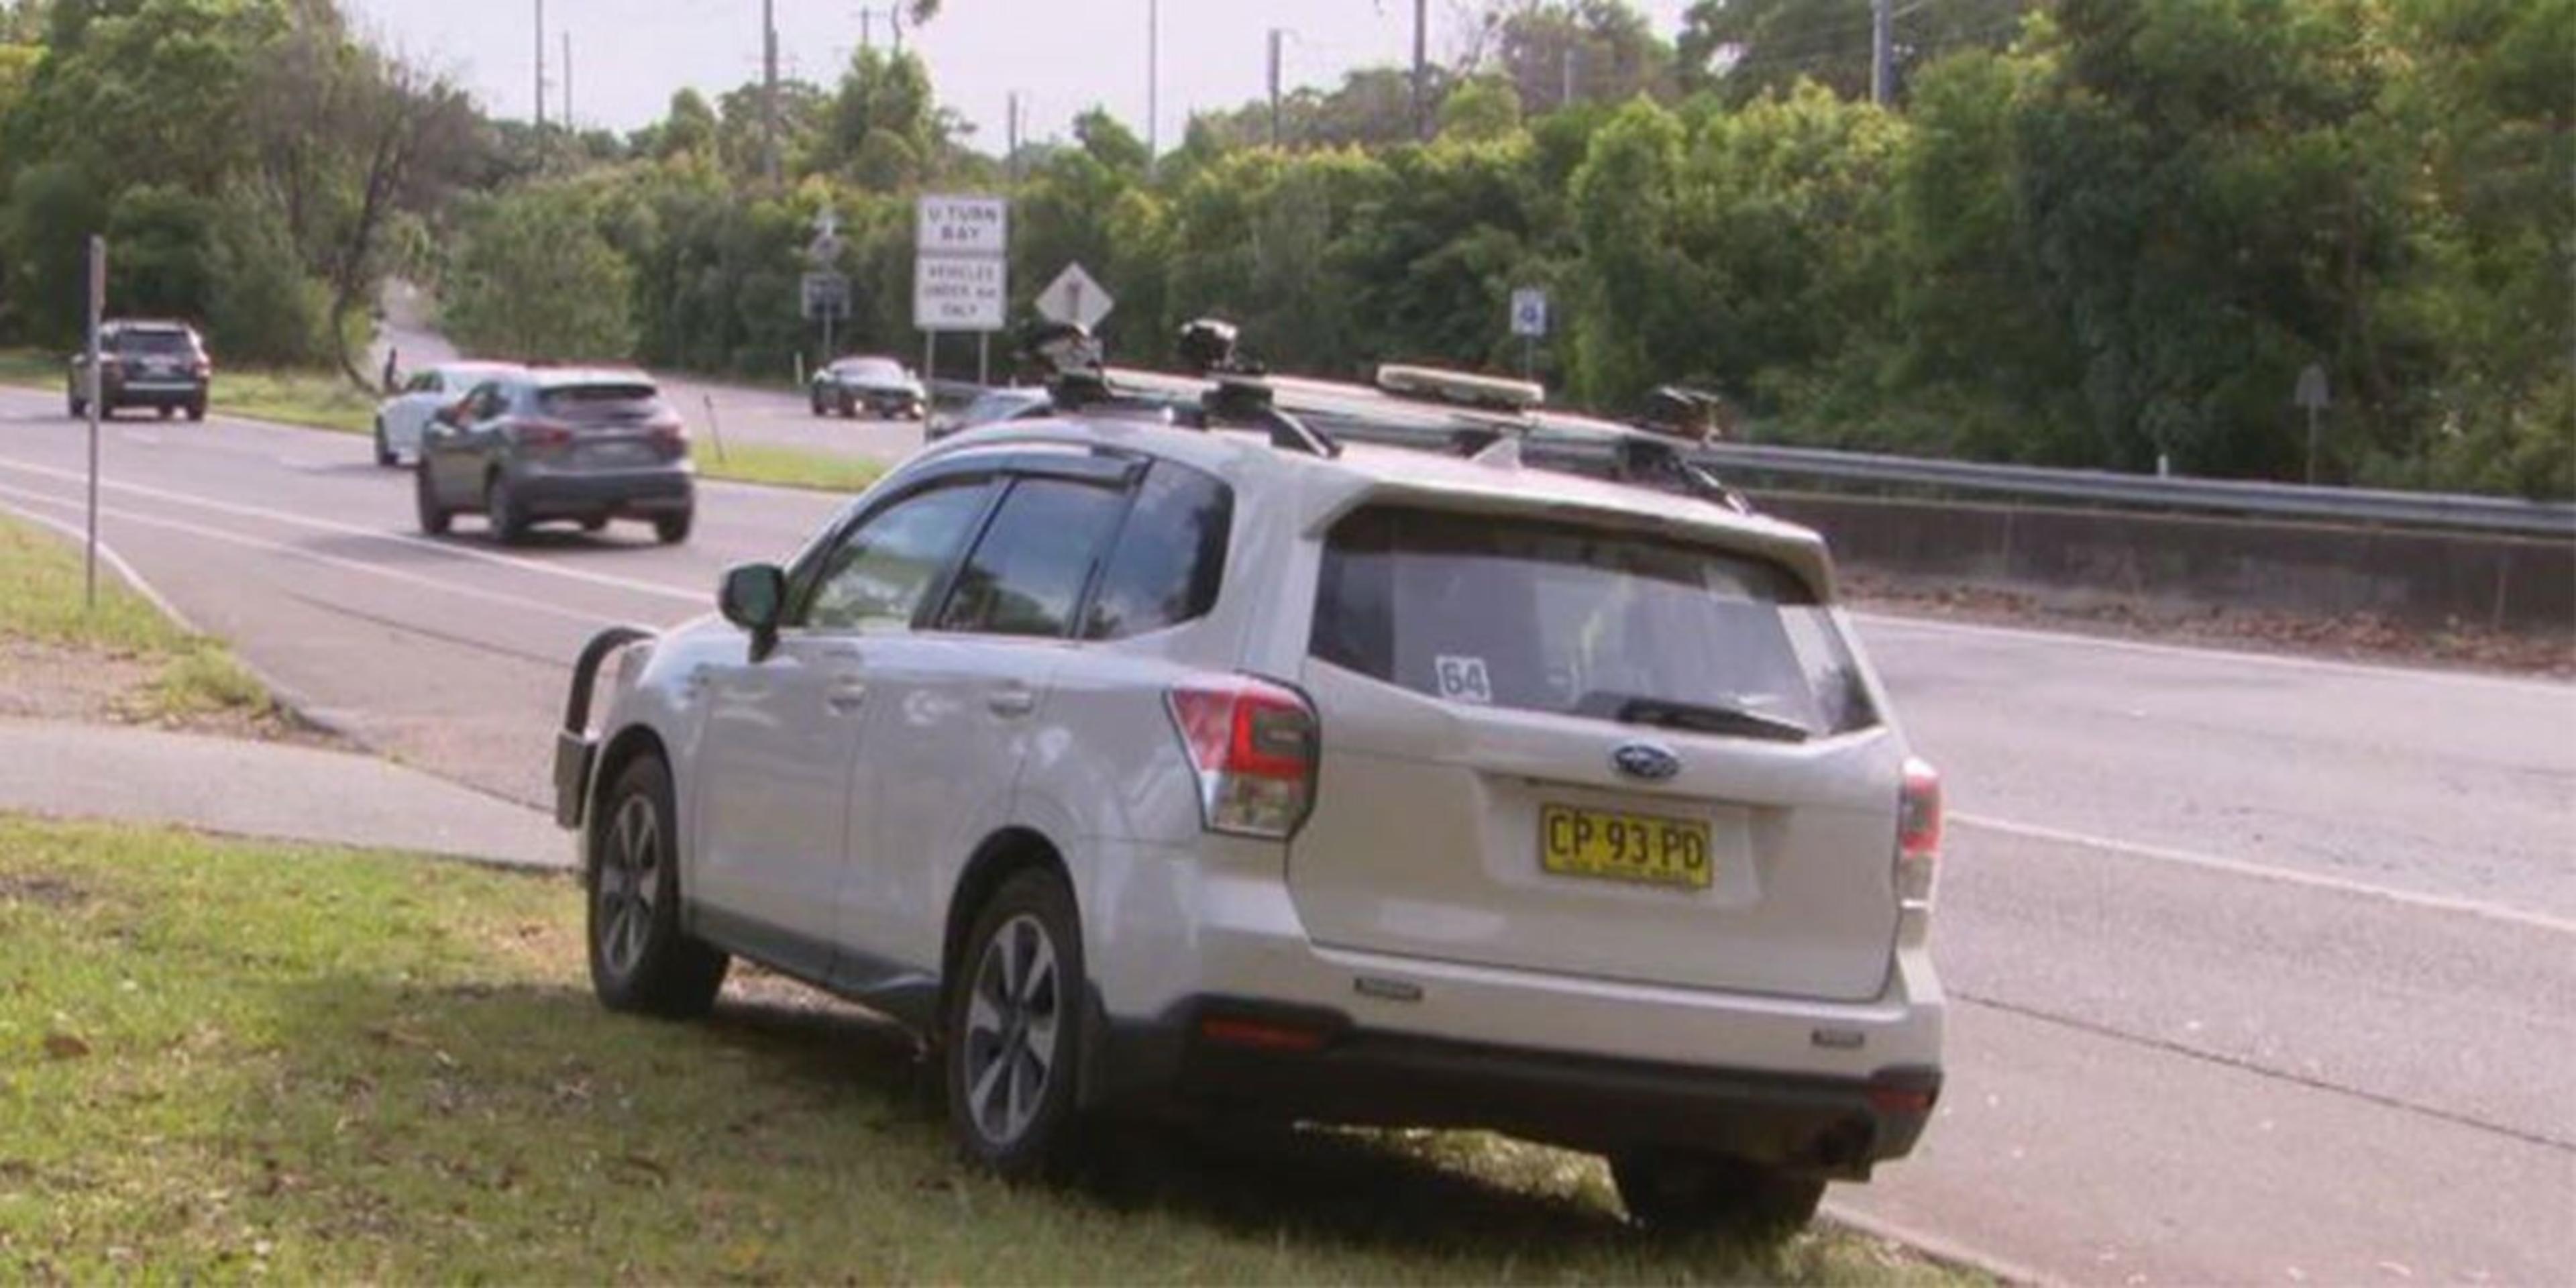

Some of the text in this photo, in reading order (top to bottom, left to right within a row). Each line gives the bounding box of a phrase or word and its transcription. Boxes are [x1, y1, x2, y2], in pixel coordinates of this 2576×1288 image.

[928, 205, 998, 223] U TURN
[941, 225, 979, 240] BAY
[1441, 661, 1487, 696] 64
[1549, 811, 1594, 857] CP
[1606, 820, 1648, 865] 93
